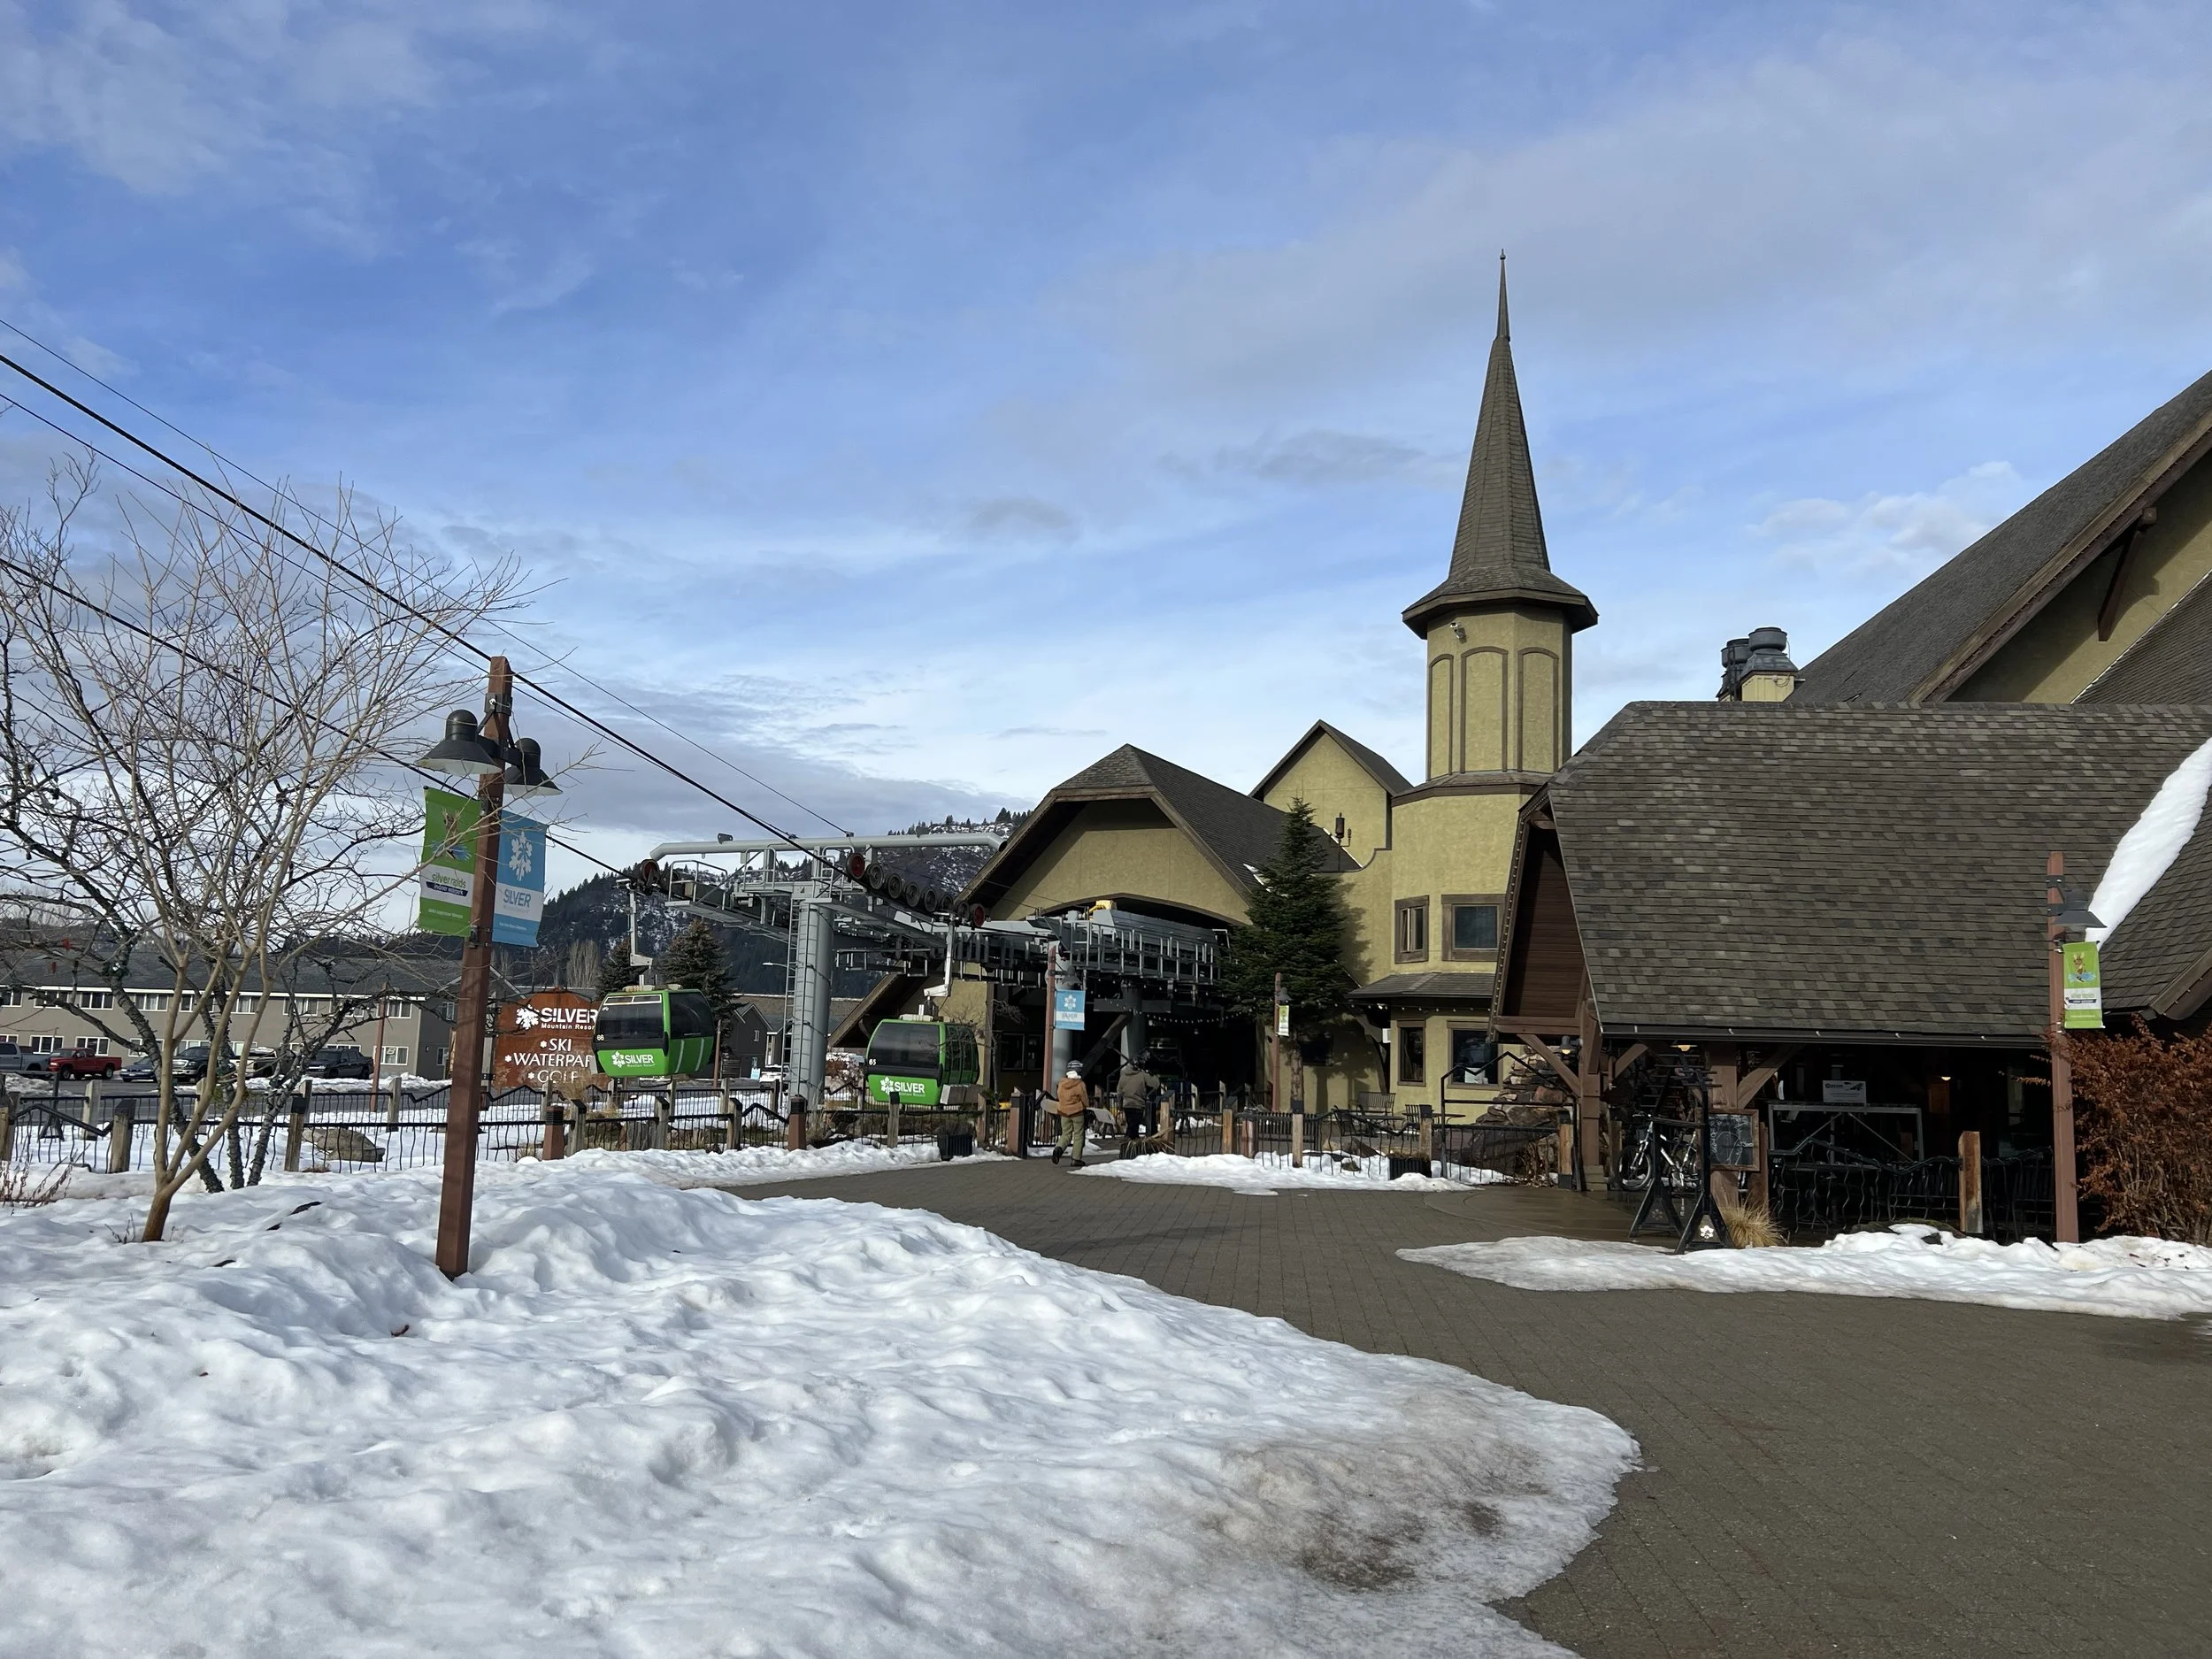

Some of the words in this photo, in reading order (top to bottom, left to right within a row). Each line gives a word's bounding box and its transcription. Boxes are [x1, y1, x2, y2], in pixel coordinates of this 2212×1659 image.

[432, 872, 450, 885] silver
[503, 888, 531, 909] SILVER
[540, 1007, 599, 1024] SILVER
[549, 1038, 572, 1051] SKI
[625, 1054, 655, 1064] SILVER
[895, 1081, 925, 1094] SILVER
